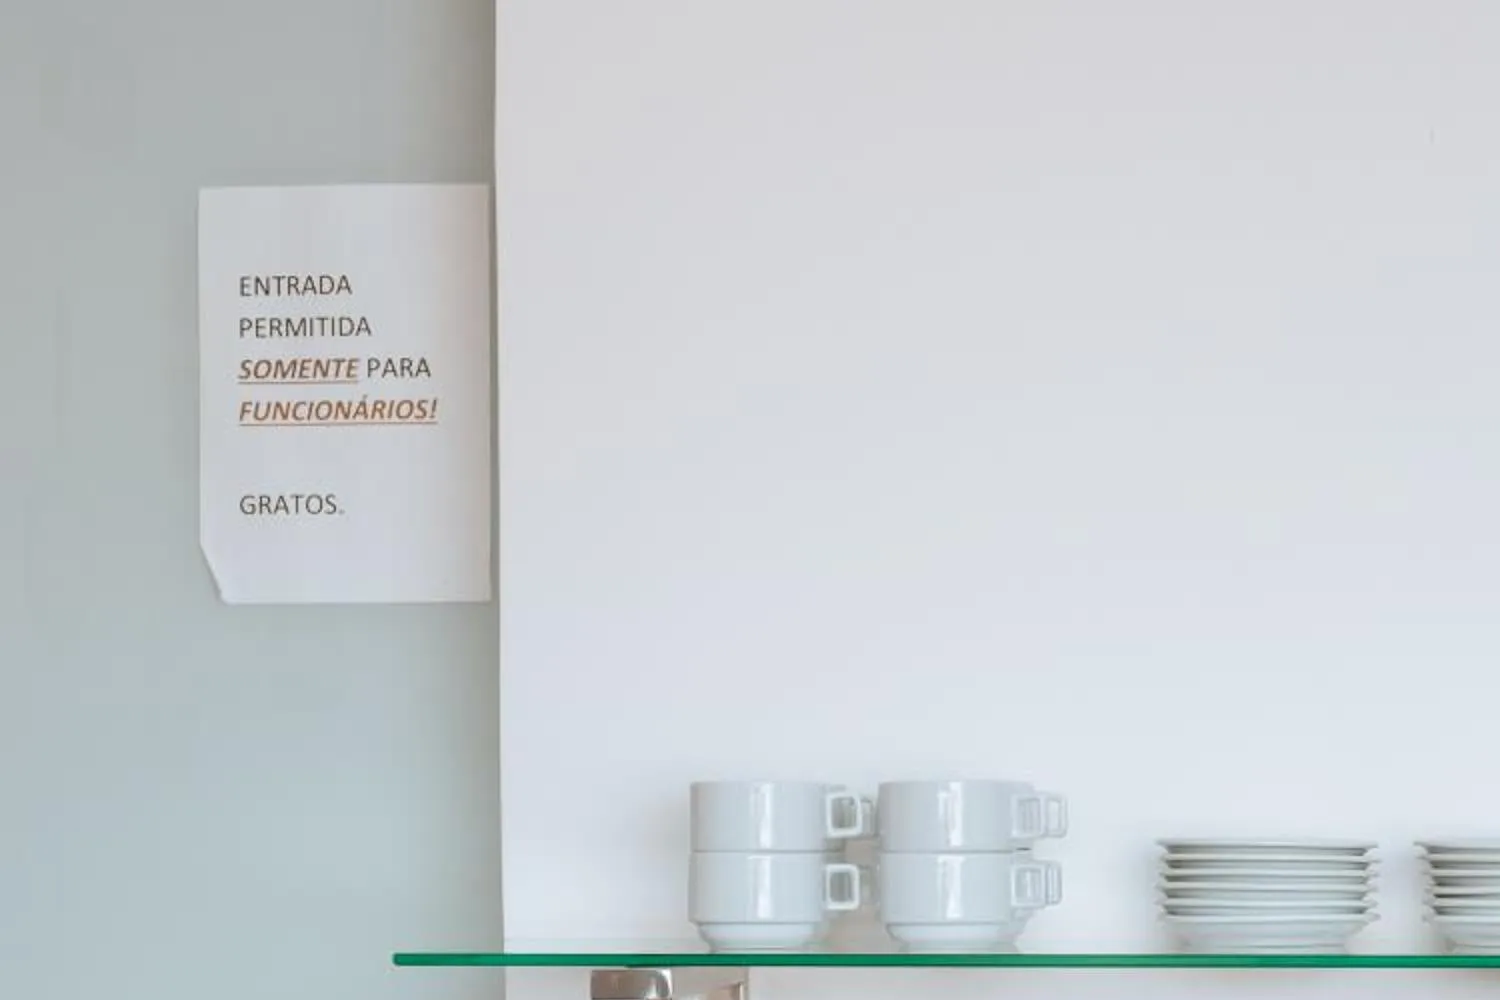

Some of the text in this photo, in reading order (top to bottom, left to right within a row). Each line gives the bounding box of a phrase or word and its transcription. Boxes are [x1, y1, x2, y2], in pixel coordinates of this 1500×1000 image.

[239, 275, 352, 297] ENTRADA
[239, 316, 372, 338] PERMITIDA
[238, 358, 432, 383] SOMENTE PARA
[239, 396, 438, 425] FUNCIONÁRIOS!
[239, 494, 345, 516] GRATOS.
